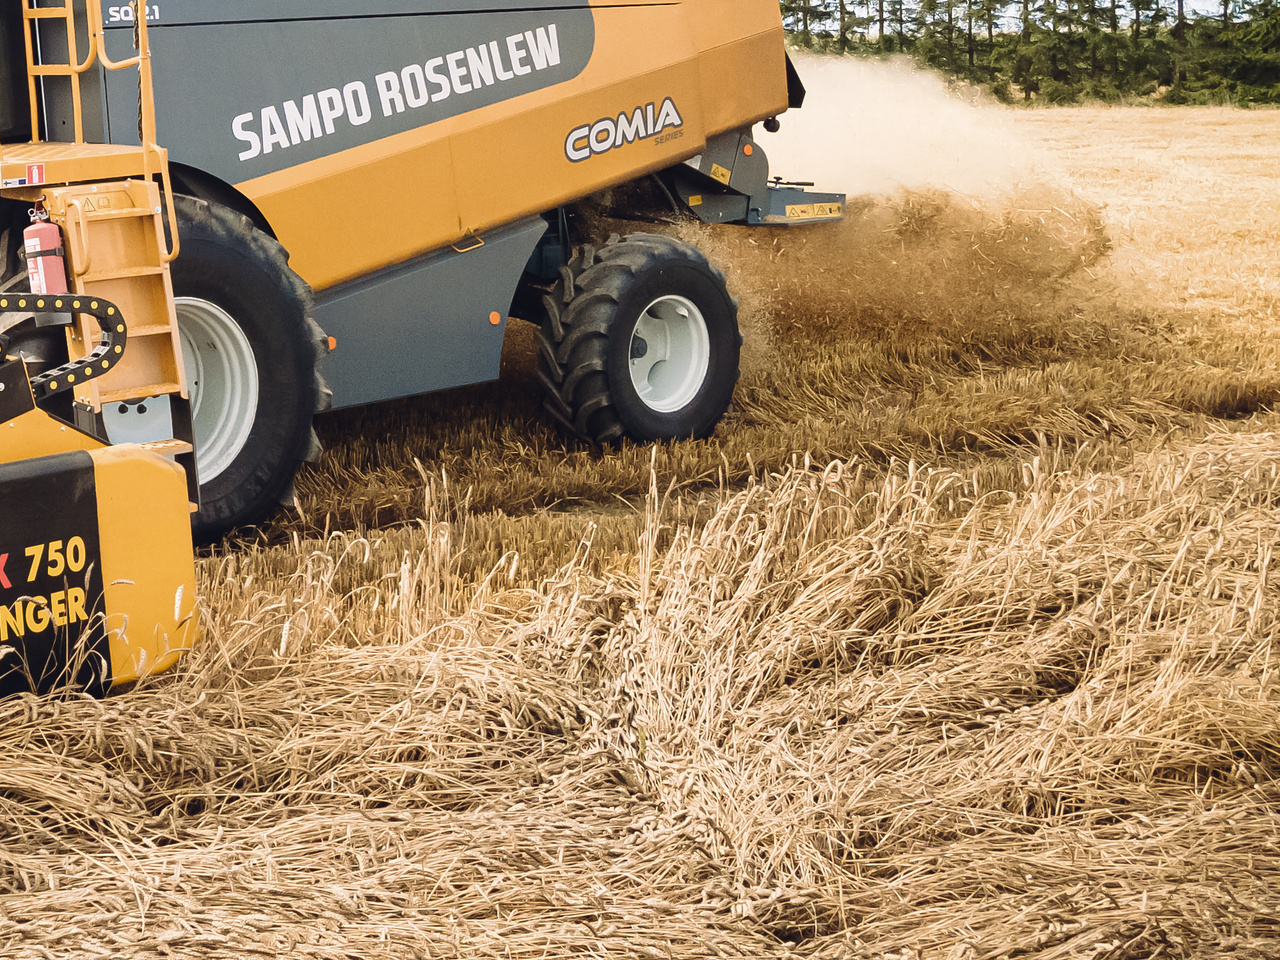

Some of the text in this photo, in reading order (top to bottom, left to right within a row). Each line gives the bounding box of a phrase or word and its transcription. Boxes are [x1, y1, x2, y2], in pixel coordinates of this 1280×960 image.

[231, 23, 562, 162] SAMPO ROSENLEW
[565, 96, 683, 162] COMIA
[654, 128, 684, 146] SERIES
[24, 535, 87, 583] 750
